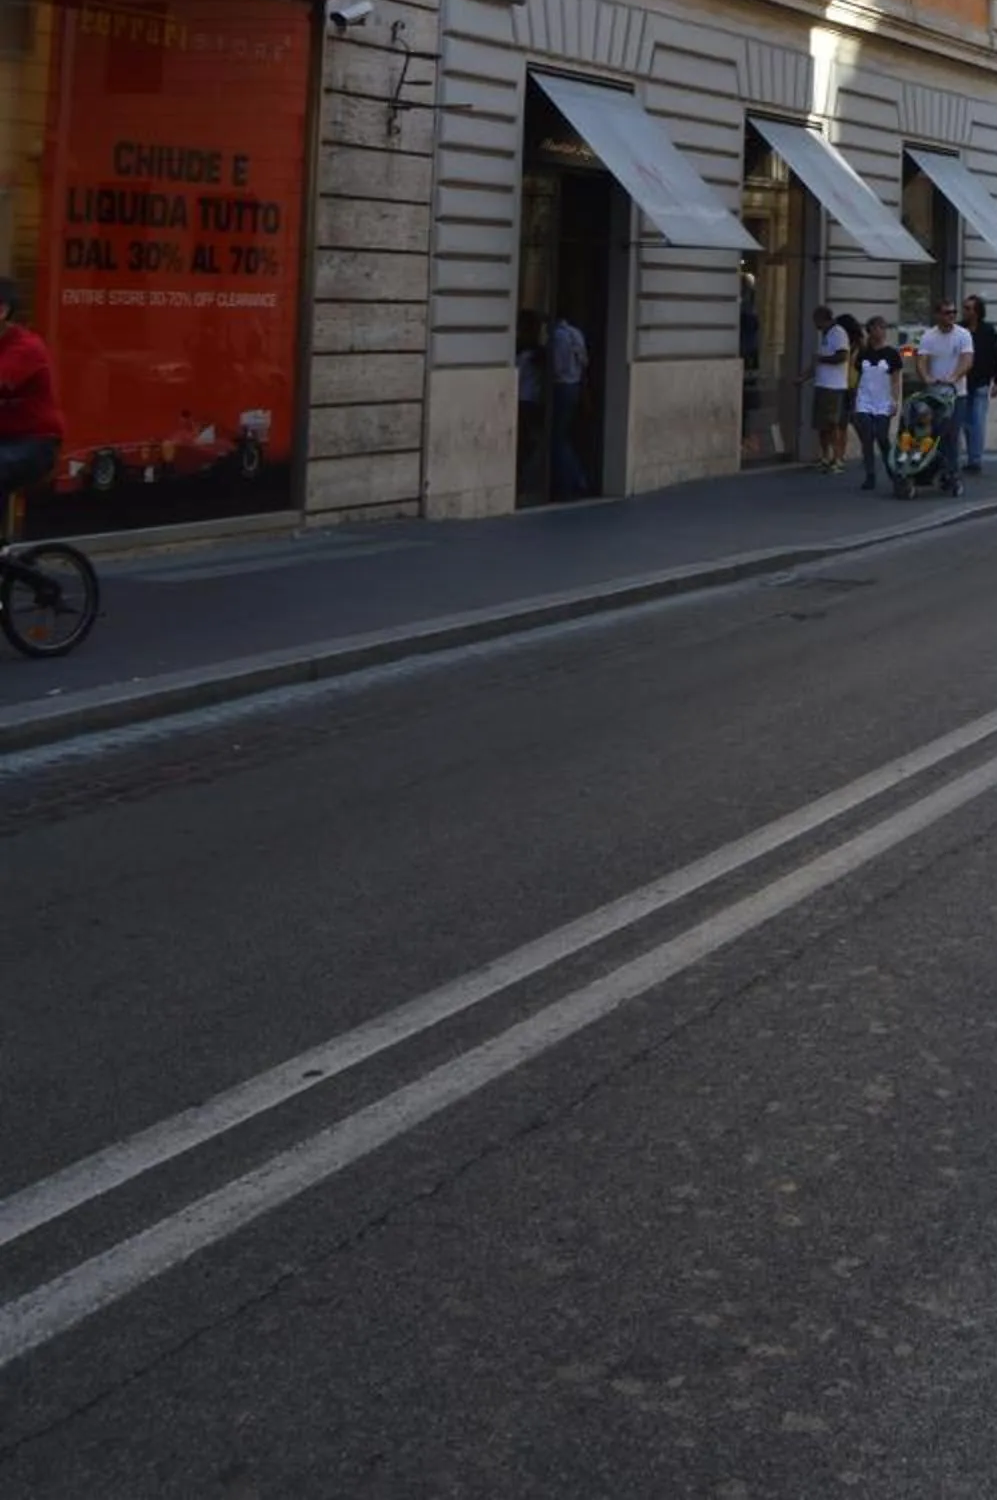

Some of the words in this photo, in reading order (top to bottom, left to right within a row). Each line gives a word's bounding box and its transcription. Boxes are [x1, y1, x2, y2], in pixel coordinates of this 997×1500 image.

[113, 140, 222, 184] CHIUDE
[231, 153, 249, 187] E
[67, 187, 187, 229] LIQUIDA
[197, 196, 280, 235] TUTTO
[64, 237, 118, 271] DAL
[128, 240, 182, 273] 30%
[191, 243, 220, 275] AL
[229, 245, 279, 277] 70%
